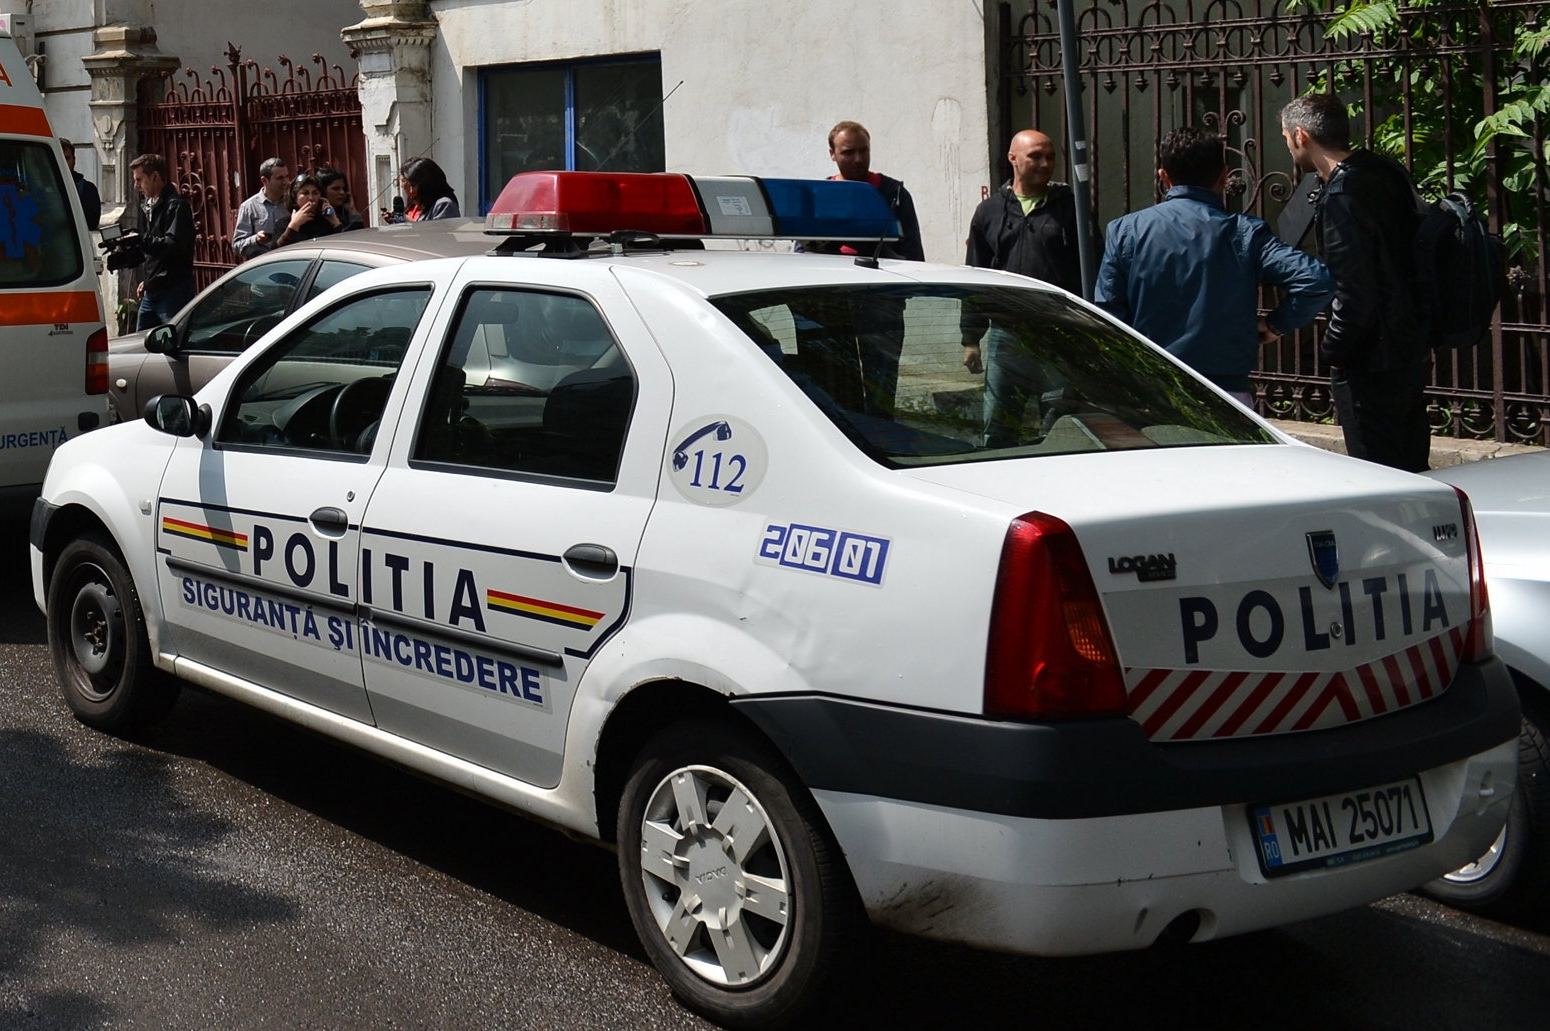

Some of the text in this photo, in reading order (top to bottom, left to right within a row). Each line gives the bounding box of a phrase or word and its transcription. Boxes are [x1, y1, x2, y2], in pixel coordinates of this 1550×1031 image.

[690, 450, 747, 493] 112
[254, 524, 487, 632] POLITIA
[1108, 553, 1176, 574] LOGAN
[1179, 568, 1450, 665] POLITIA
[361, 618, 544, 704] ÎNCREDERE
[1264, 840, 1281, 860] RO
[1284, 801, 1338, 856] MAI
[1341, 784, 1419, 844] 25071
